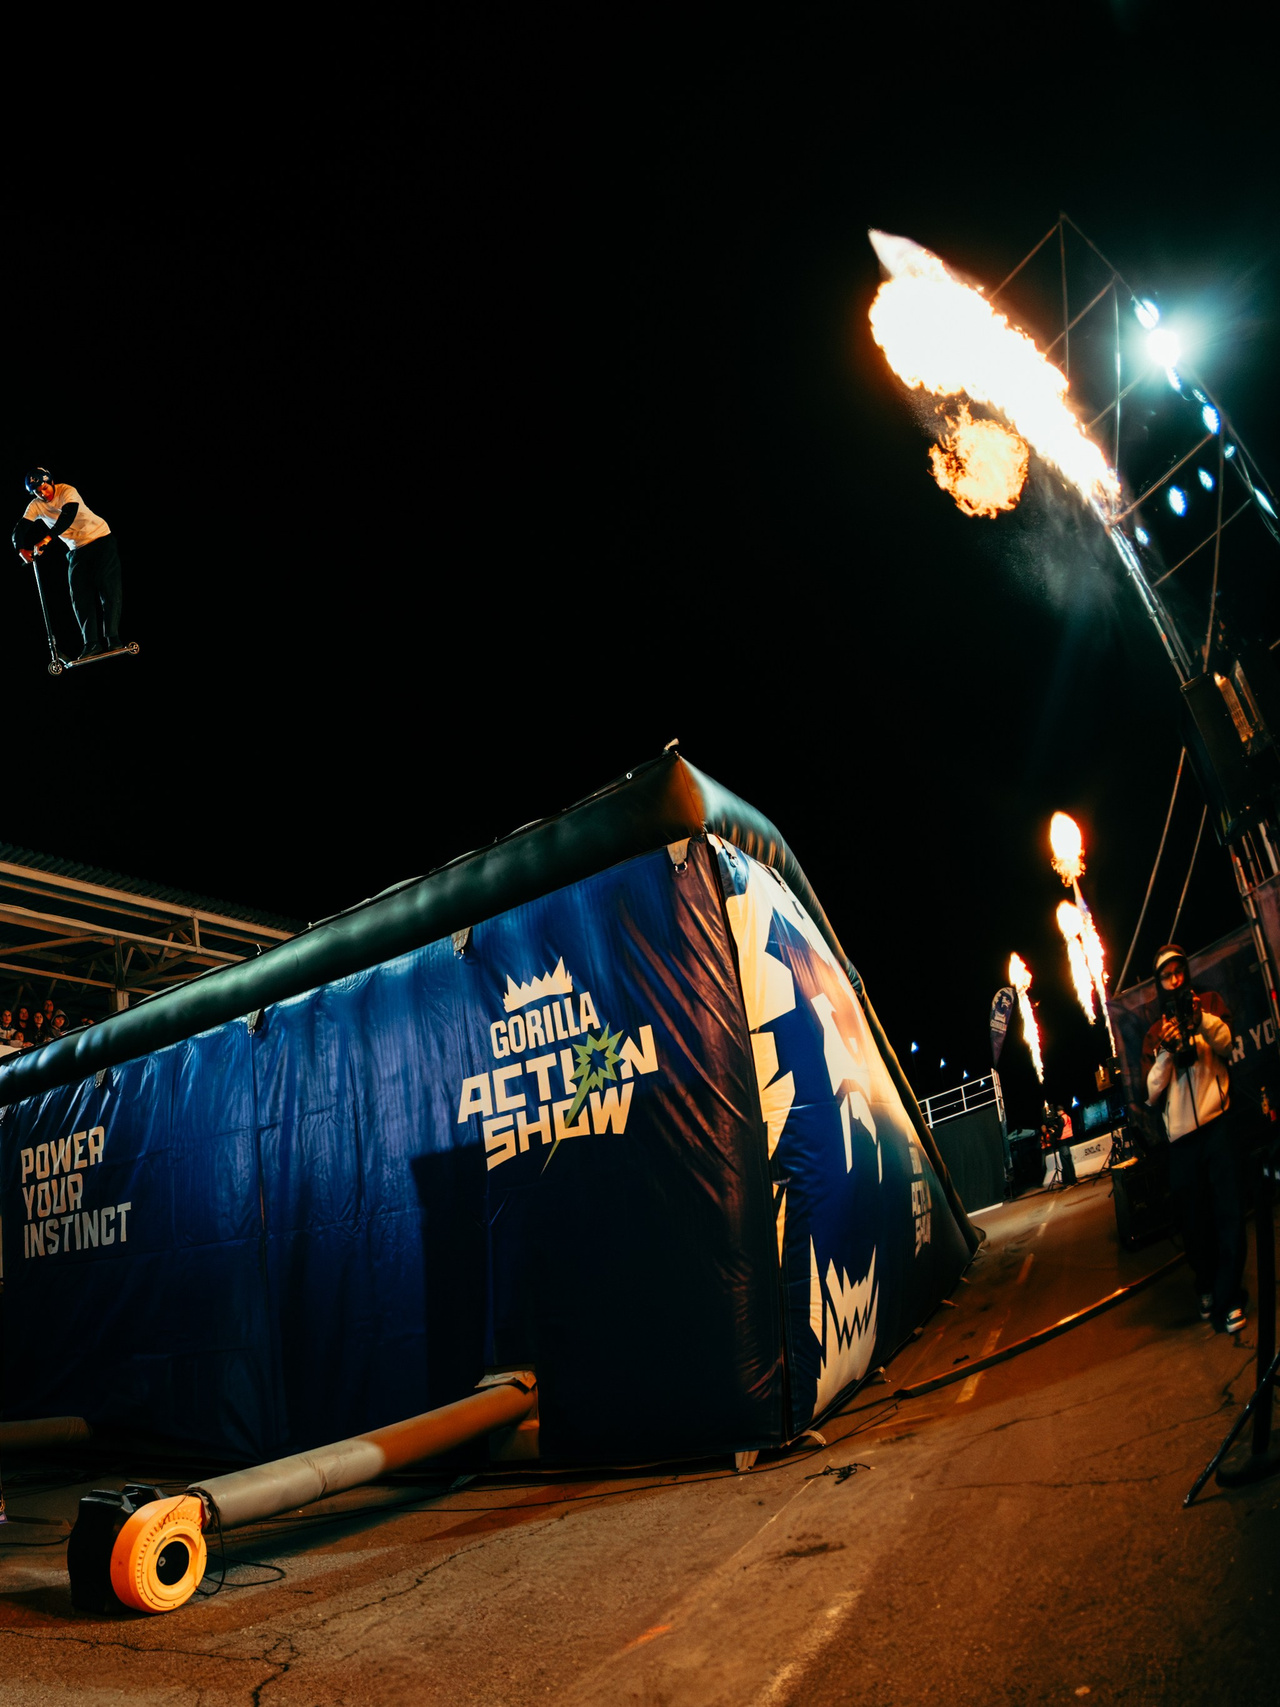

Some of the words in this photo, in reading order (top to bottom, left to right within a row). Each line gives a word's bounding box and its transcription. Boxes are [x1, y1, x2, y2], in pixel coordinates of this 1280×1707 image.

[489, 990, 601, 1060] GORILLA
[457, 1023, 659, 1124] ACTION
[20, 1125, 106, 1185] POWER
[482, 1081, 635, 1172] SHOW
[21, 1172, 84, 1221] YOUR
[23, 1201, 132, 1259] INSTINCT
